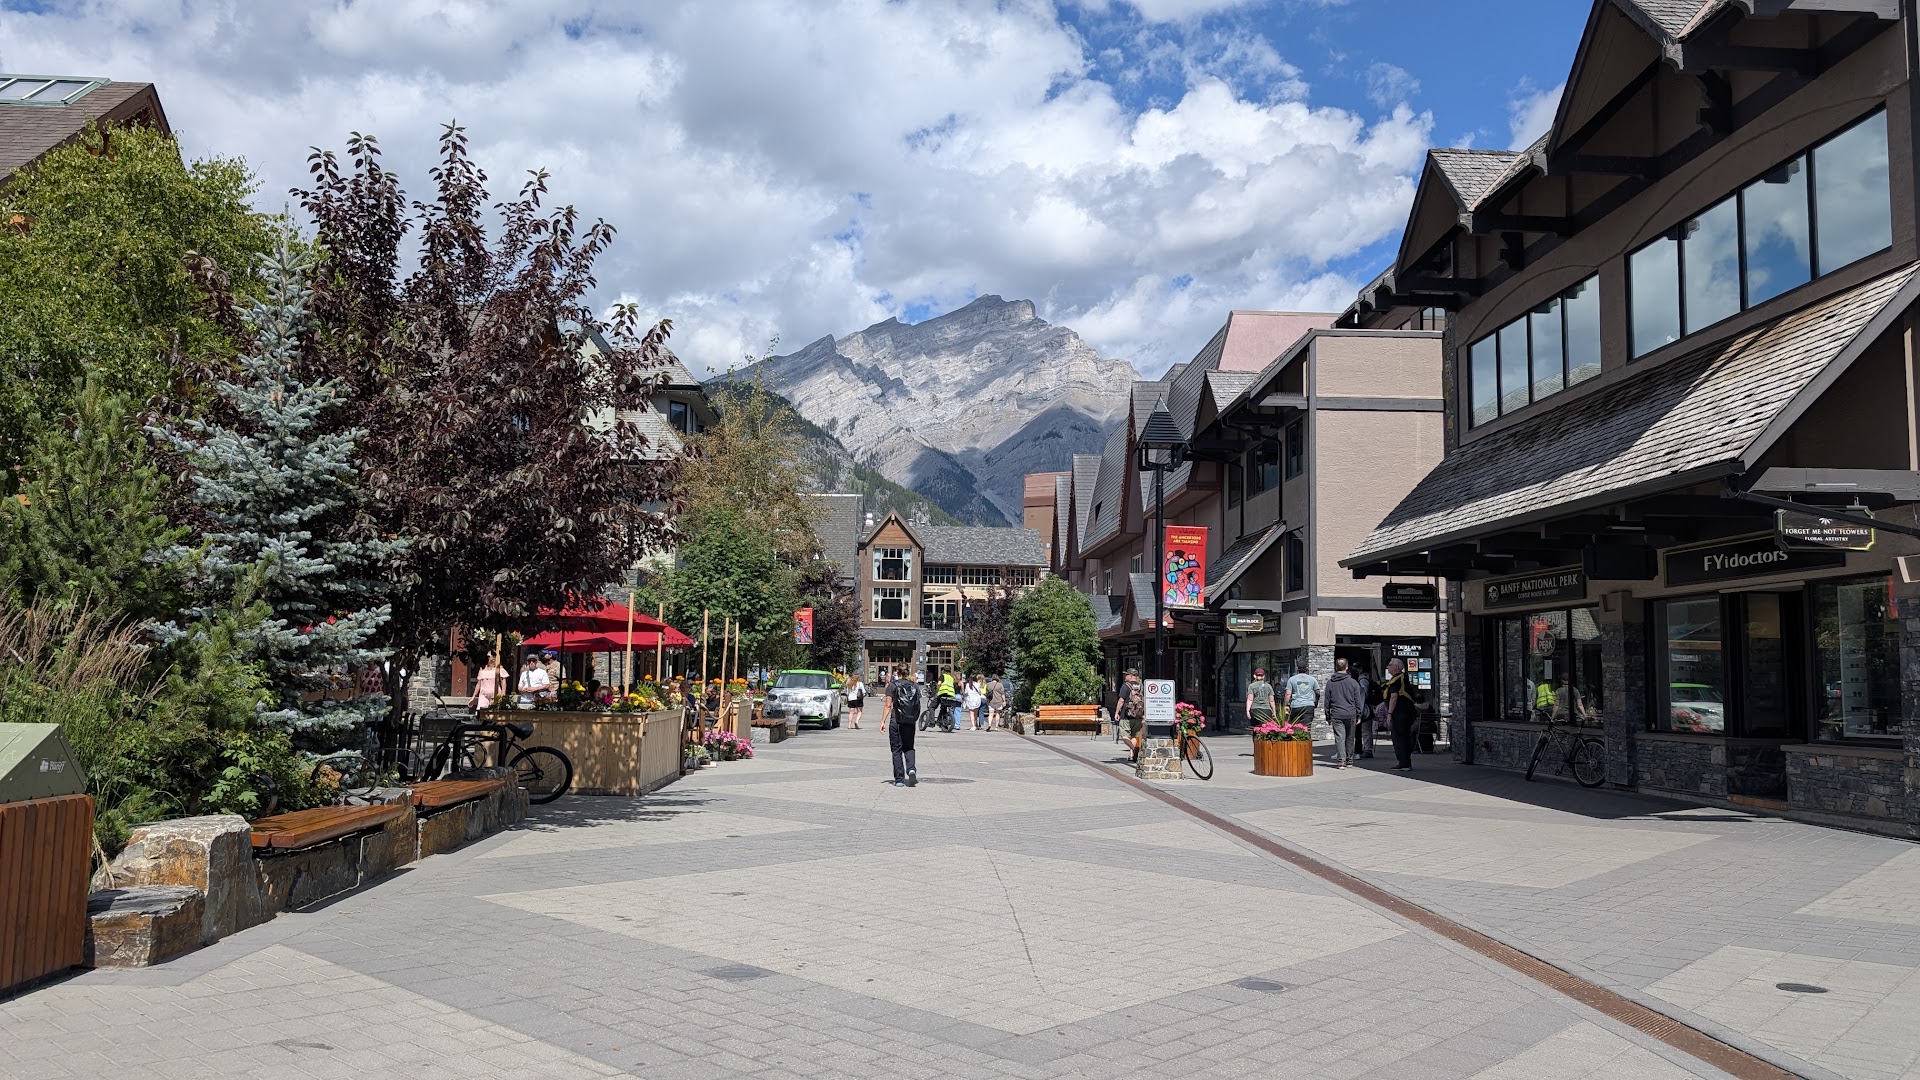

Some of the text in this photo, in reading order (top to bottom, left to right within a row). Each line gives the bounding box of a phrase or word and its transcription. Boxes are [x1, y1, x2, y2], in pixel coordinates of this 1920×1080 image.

[1703, 550, 1789, 571] FYidoctors
[1500, 574, 1578, 594] BANFF NATIONAL PERK
[1538, 640, 1553, 649] PERK
